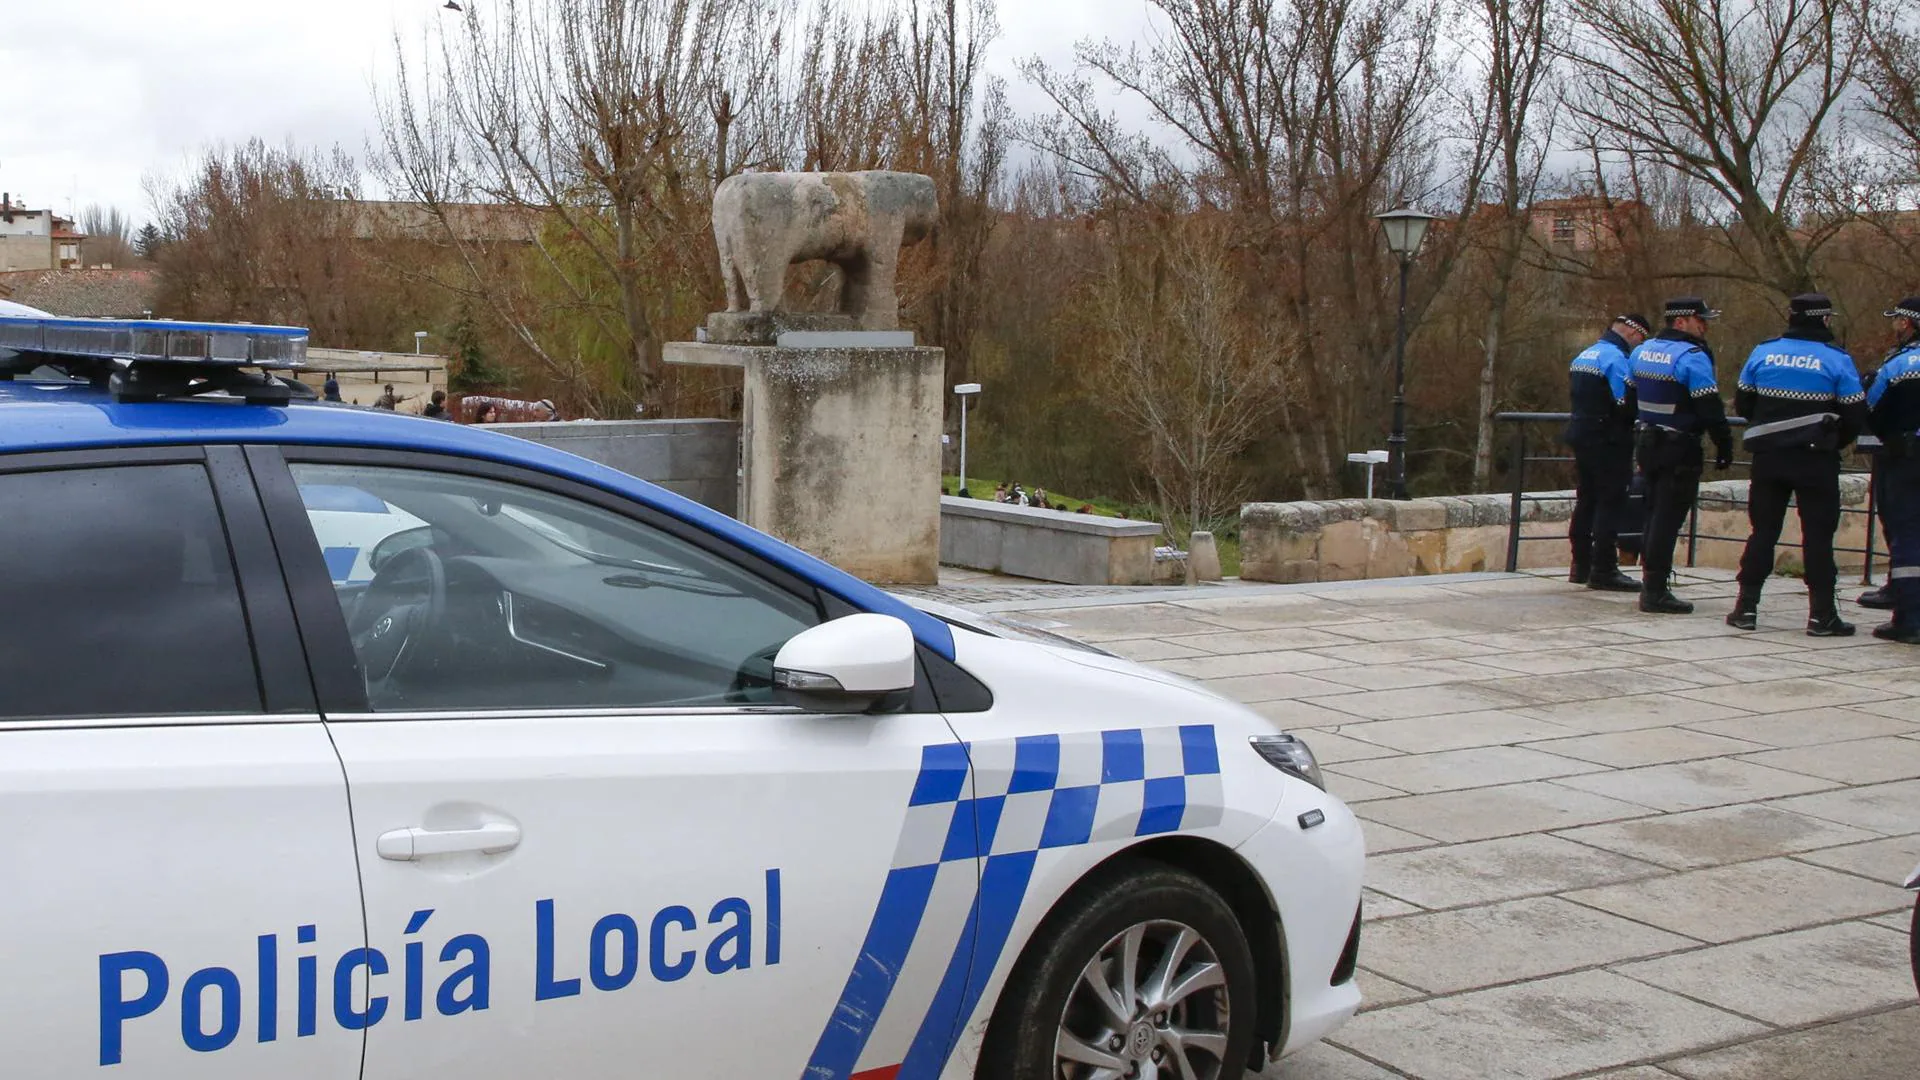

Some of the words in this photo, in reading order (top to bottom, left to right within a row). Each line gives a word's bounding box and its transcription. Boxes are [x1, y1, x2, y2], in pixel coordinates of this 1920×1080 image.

[1765, 354, 1822, 370] POLICÍA
[99, 909, 490, 1066] Policía
[536, 868, 782, 1001] Local
